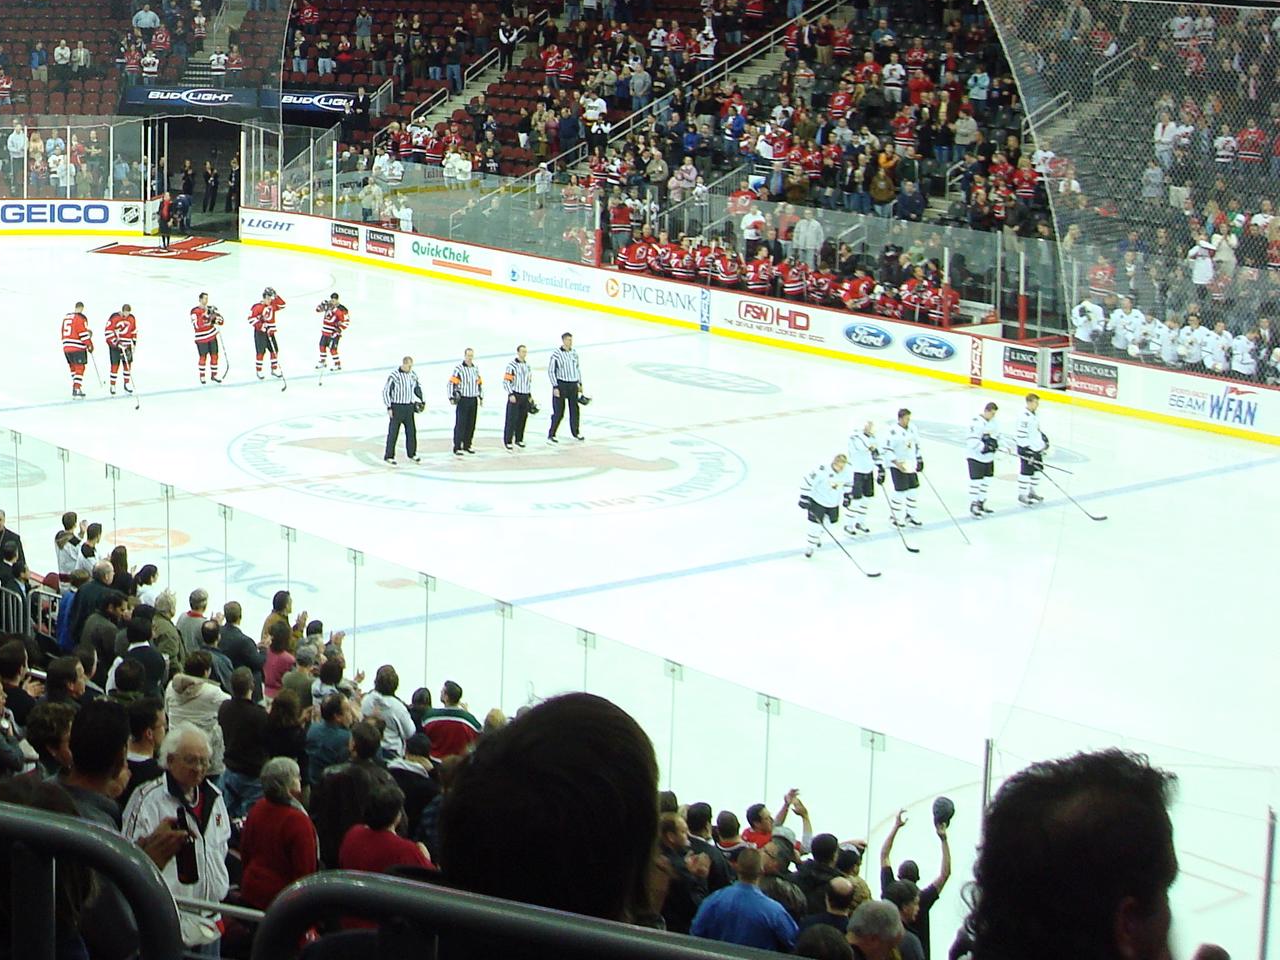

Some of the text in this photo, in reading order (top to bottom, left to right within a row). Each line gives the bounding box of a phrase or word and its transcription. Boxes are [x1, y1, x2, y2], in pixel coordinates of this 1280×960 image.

[148, 91, 233, 102] BUD LIGHT
[281, 95, 314, 105] BUD
[0, 203, 110, 225] GEICO
[247, 218, 295, 232] LIGHT
[412, 240, 470, 264] QuickChek
[522, 270, 590, 293] Prudential Center
[744, 303, 809, 331] FSN HD
[63, 319, 72, 337] 5
[852, 327, 885, 347] Ford
[912, 338, 947, 358] Ford
[1074, 362, 1117, 378] LINCOLN
[1209, 389, 1258, 426] WFAN
[161, 546, 319, 600] PNC
